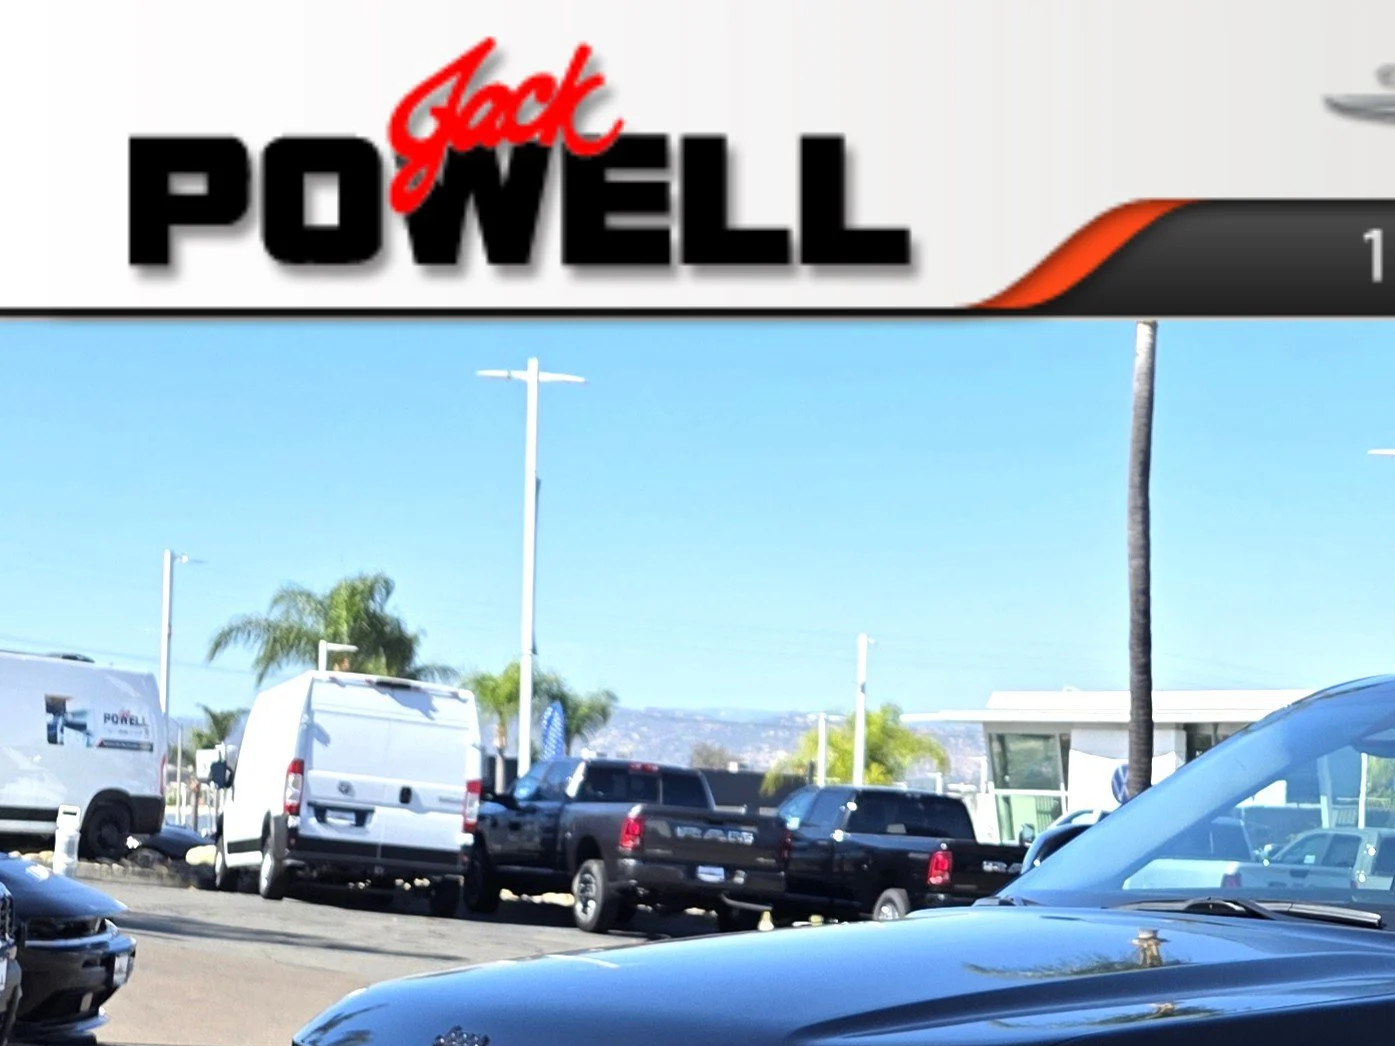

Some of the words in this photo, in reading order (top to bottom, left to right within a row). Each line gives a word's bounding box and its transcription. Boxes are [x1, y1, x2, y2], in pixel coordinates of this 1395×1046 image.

[103, 711, 149, 727] POWELL
[676, 826, 754, 846] RAM
[982, 860, 1024, 873] RA
